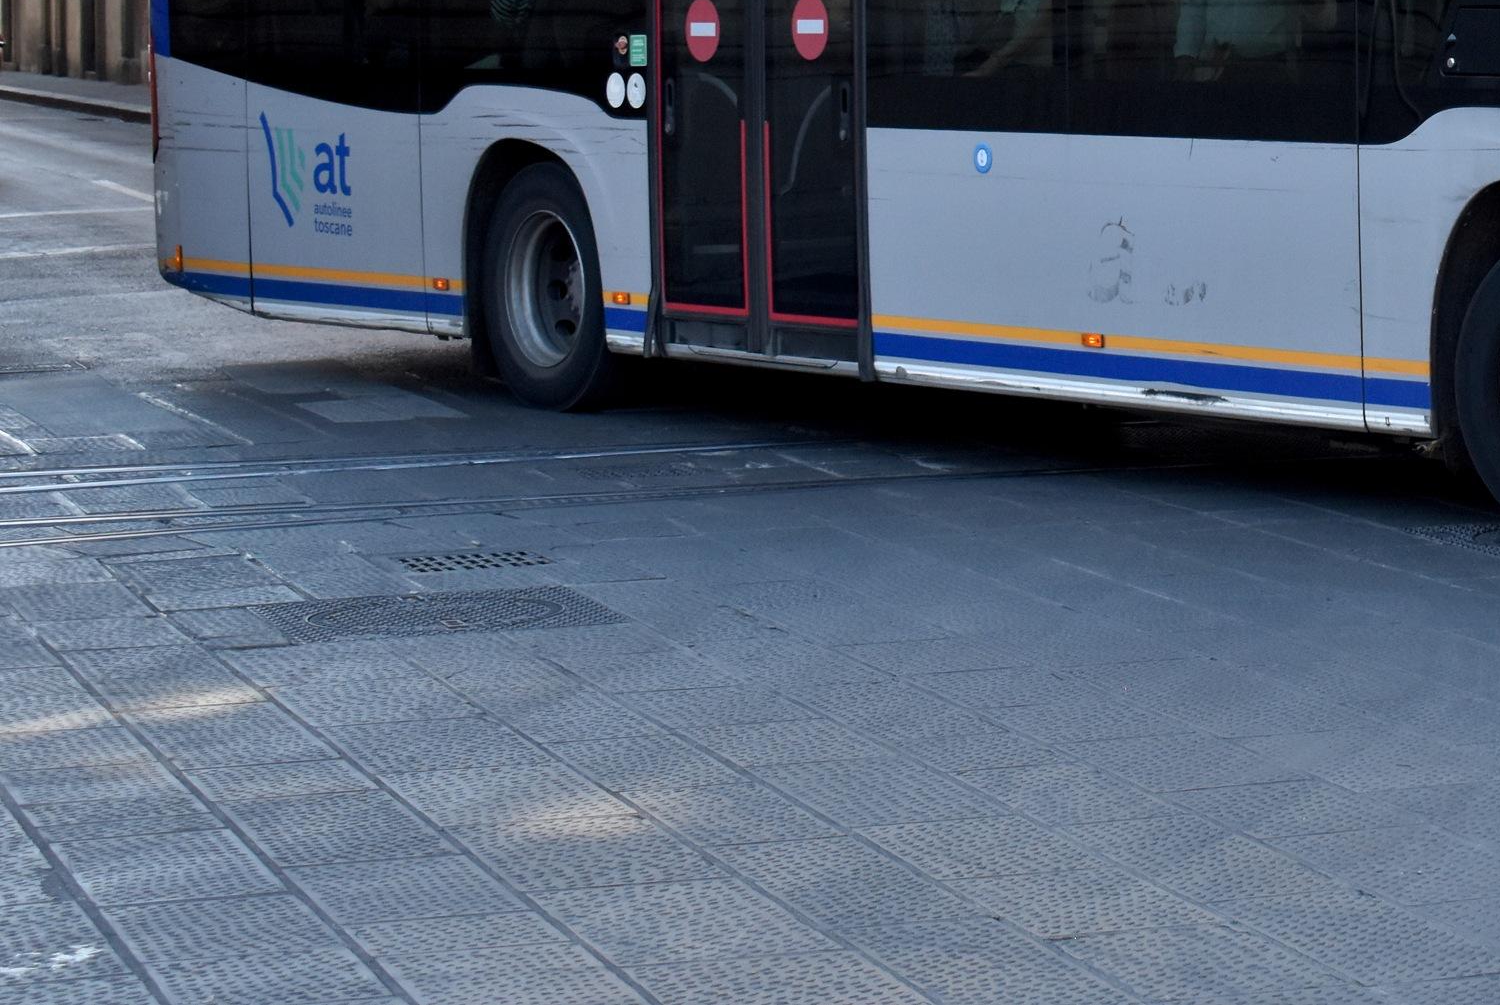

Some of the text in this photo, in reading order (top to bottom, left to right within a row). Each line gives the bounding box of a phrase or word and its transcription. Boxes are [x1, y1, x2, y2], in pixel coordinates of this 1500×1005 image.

[313, 132, 351, 196] at
[313, 202, 352, 218] autolinee
[314, 218, 352, 236] toscane
